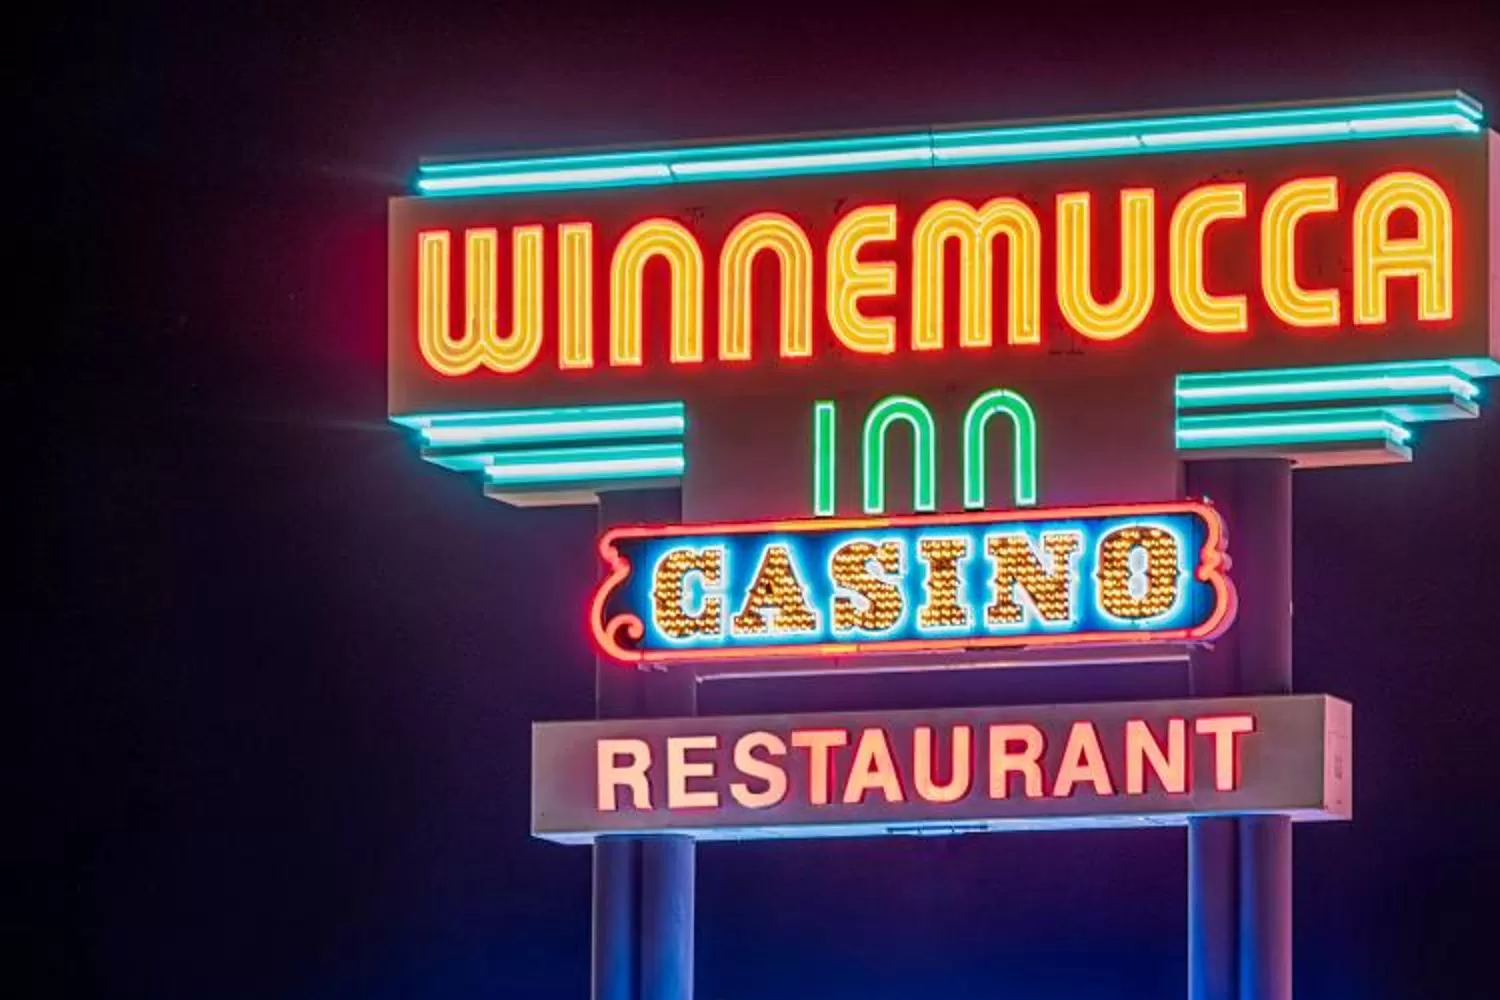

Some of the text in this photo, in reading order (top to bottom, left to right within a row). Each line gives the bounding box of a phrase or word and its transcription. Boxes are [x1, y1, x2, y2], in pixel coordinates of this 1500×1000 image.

[416, 171, 1453, 376] WINNEMUCCA
[812, 388, 1038, 517] INN
[649, 523, 1188, 638] CASINO
[596, 715, 1256, 812] RESTAURANT
